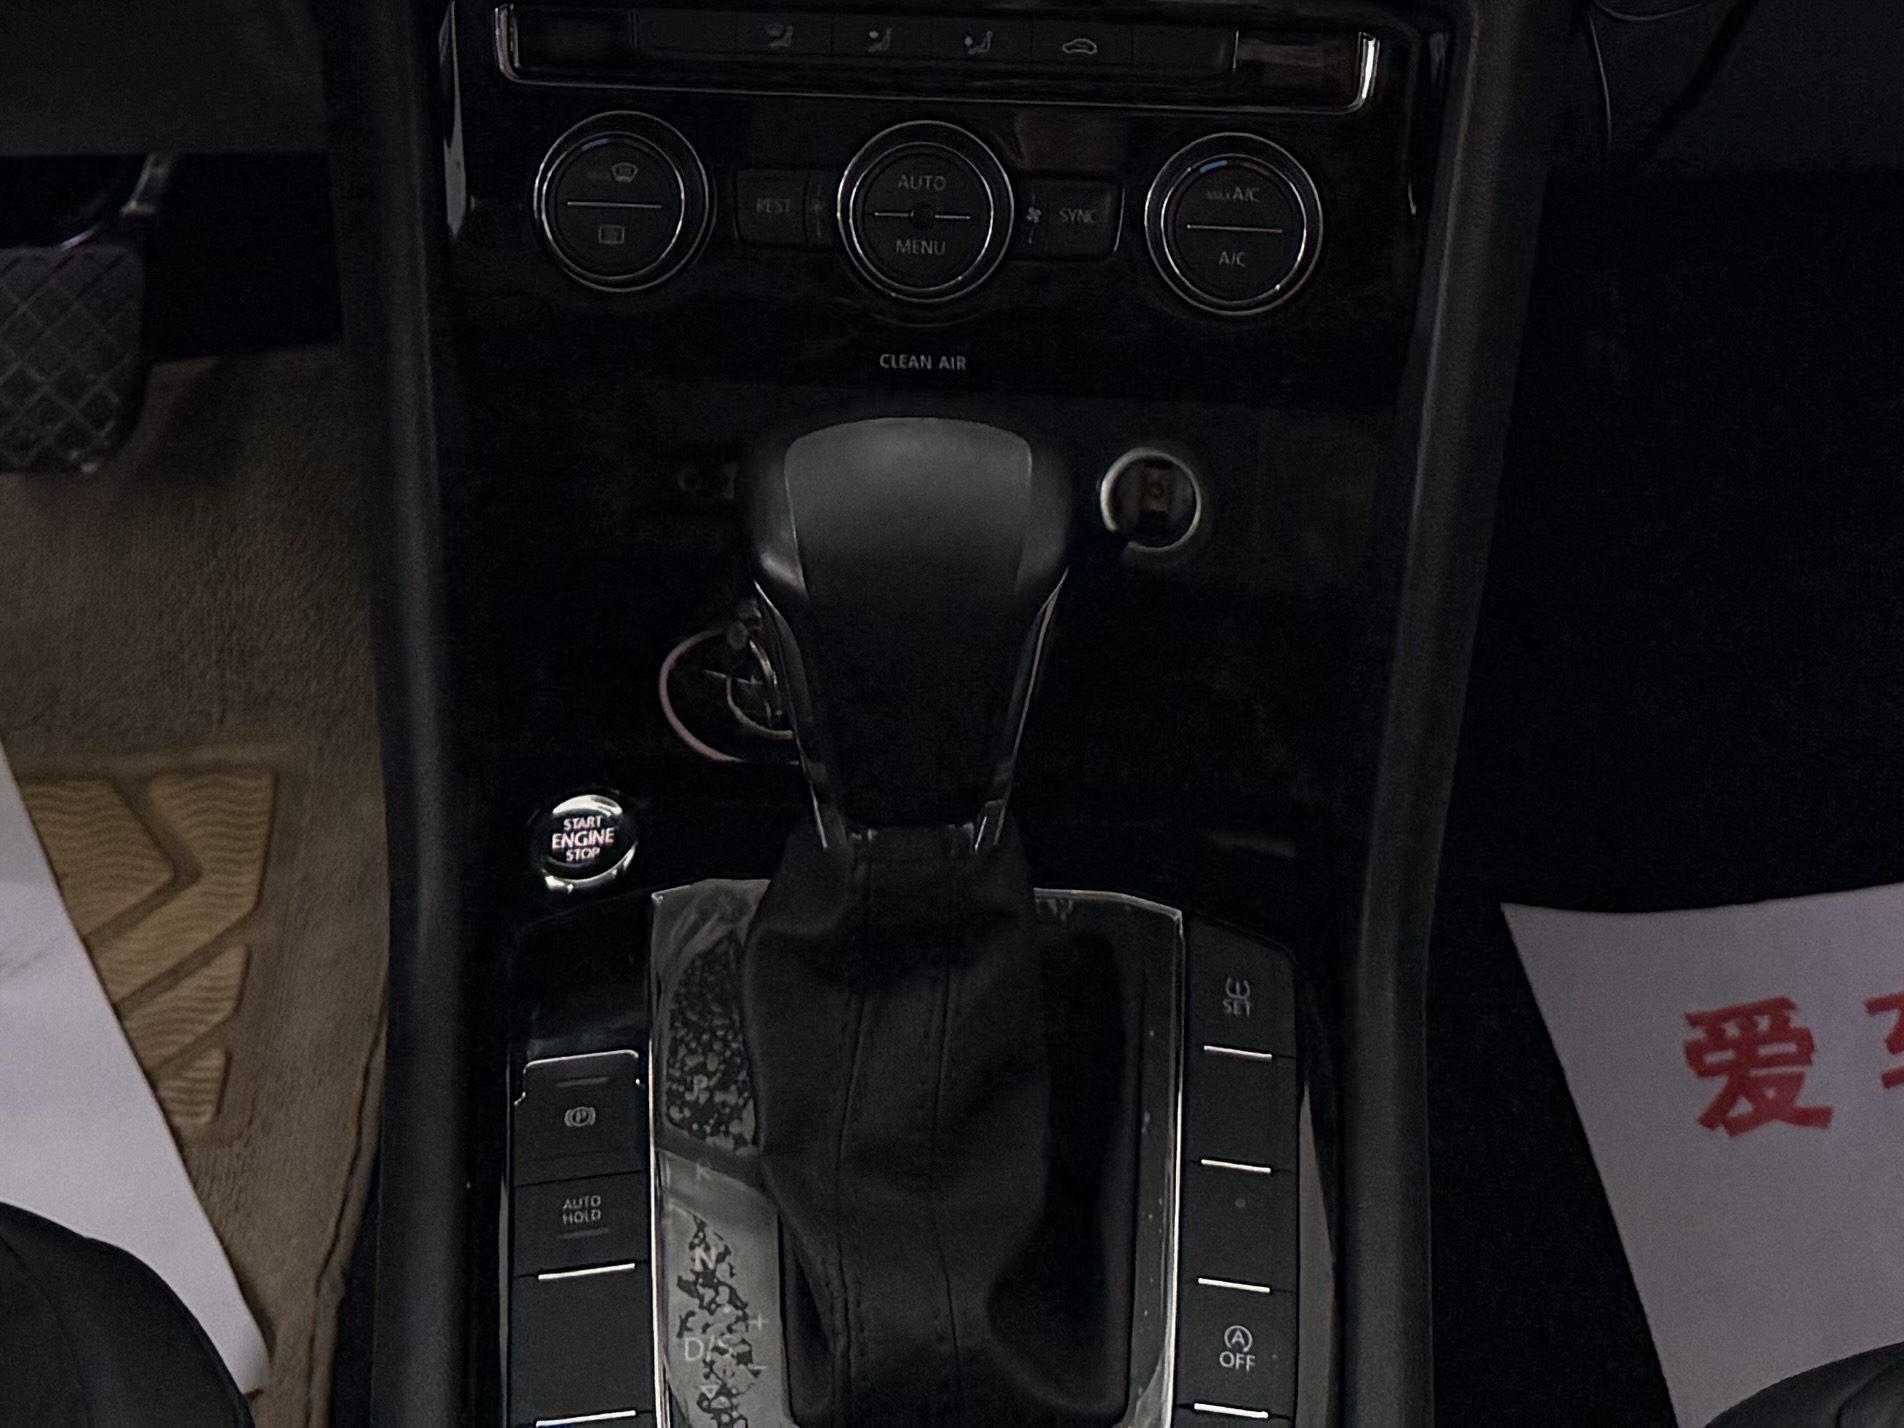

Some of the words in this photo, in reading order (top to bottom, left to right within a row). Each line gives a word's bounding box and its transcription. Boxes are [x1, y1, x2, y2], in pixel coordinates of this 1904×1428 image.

[898, 174, 946, 192] AUTO
[1232, 186, 1260, 203] A/C
[1059, 207, 1097, 225] SYNC
[896, 238, 946, 257] MENU
[1218, 250, 1247, 268] A/C
[879, 353, 933, 372] CLEAN
[937, 355, 967, 372] AIR
[563, 814, 603, 831] START
[551, 826, 616, 851] ENGINE
[565, 846, 601, 862] STOP
[1222, 999, 1252, 1017] SET
[563, 1194, 602, 1210] AUTO
[562, 1208, 602, 1225] HOLD
[1218, 1350, 1257, 1373] OFF
